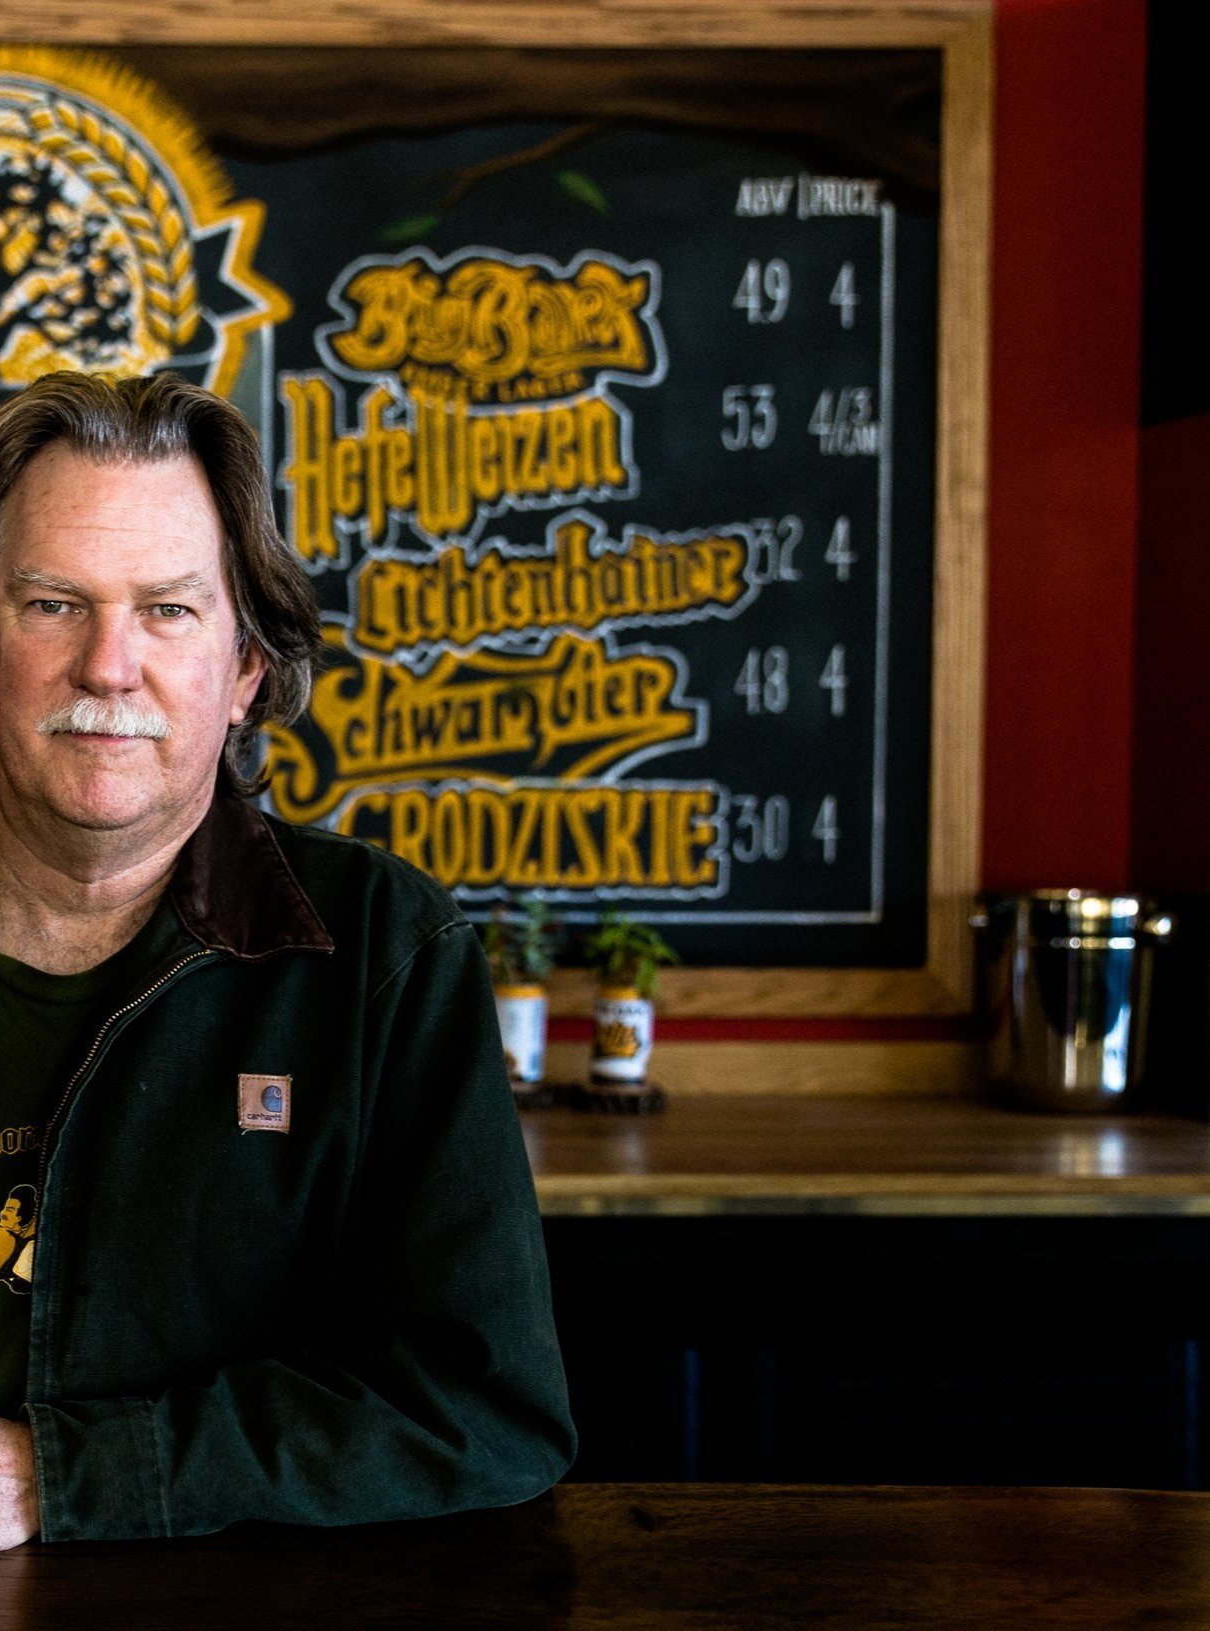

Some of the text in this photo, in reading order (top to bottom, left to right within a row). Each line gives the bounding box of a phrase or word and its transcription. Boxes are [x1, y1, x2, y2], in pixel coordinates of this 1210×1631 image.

[735, 177, 882, 217] ABV PRICE
[829, 260, 861, 329] 4
[824, 516, 857, 582] 4
[819, 644, 850, 717] 4
[811, 795, 841, 864] 4
